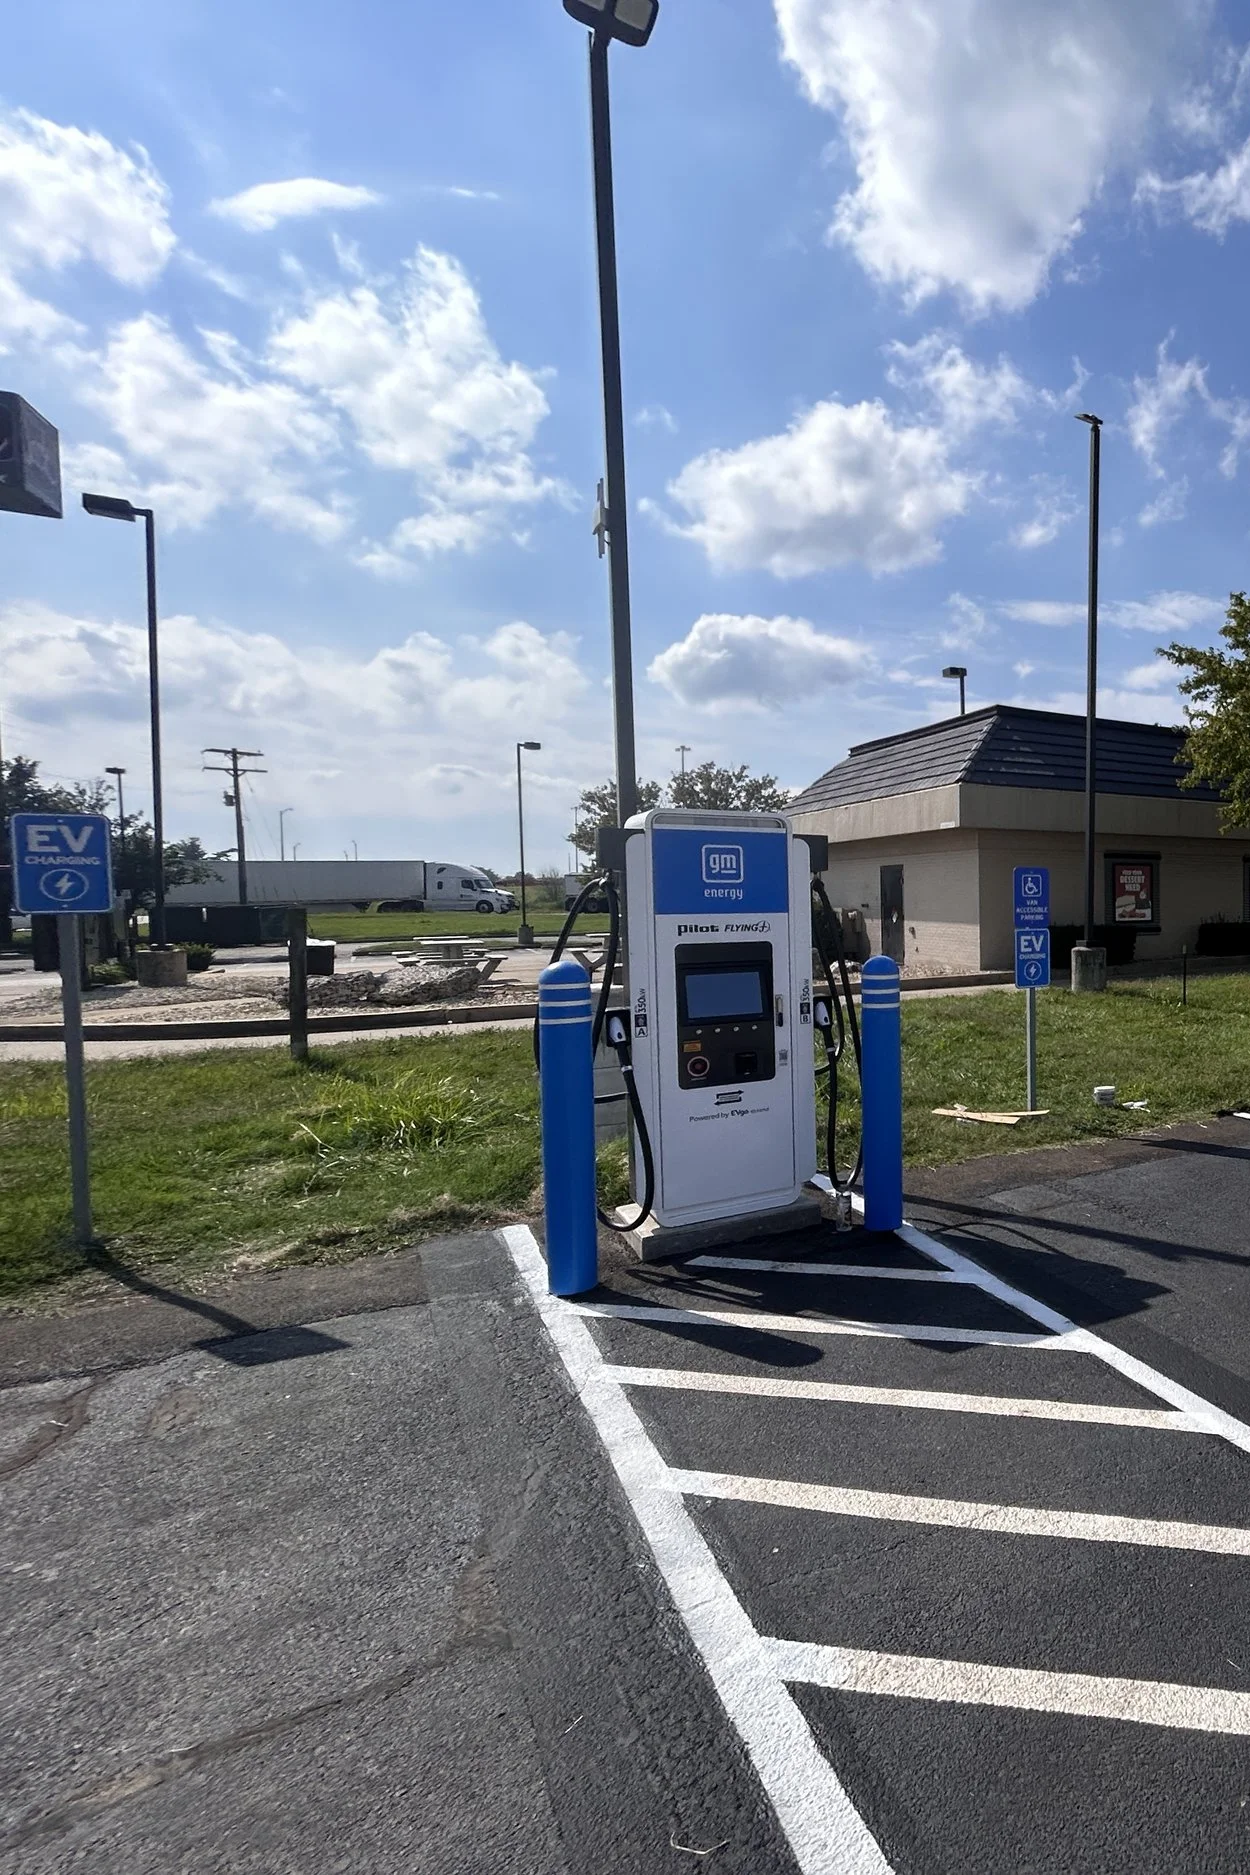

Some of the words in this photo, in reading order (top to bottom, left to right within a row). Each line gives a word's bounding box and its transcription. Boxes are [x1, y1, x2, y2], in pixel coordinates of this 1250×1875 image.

[26, 824, 94, 853] EV
[24, 855, 101, 866] CHARGING
[709, 854, 737, 874] gm
[704, 888, 743, 900] energy
[1020, 935, 1045, 952] EV
[689, 1112, 720, 1122] Powered
[720, 1110, 730, 1119] by
